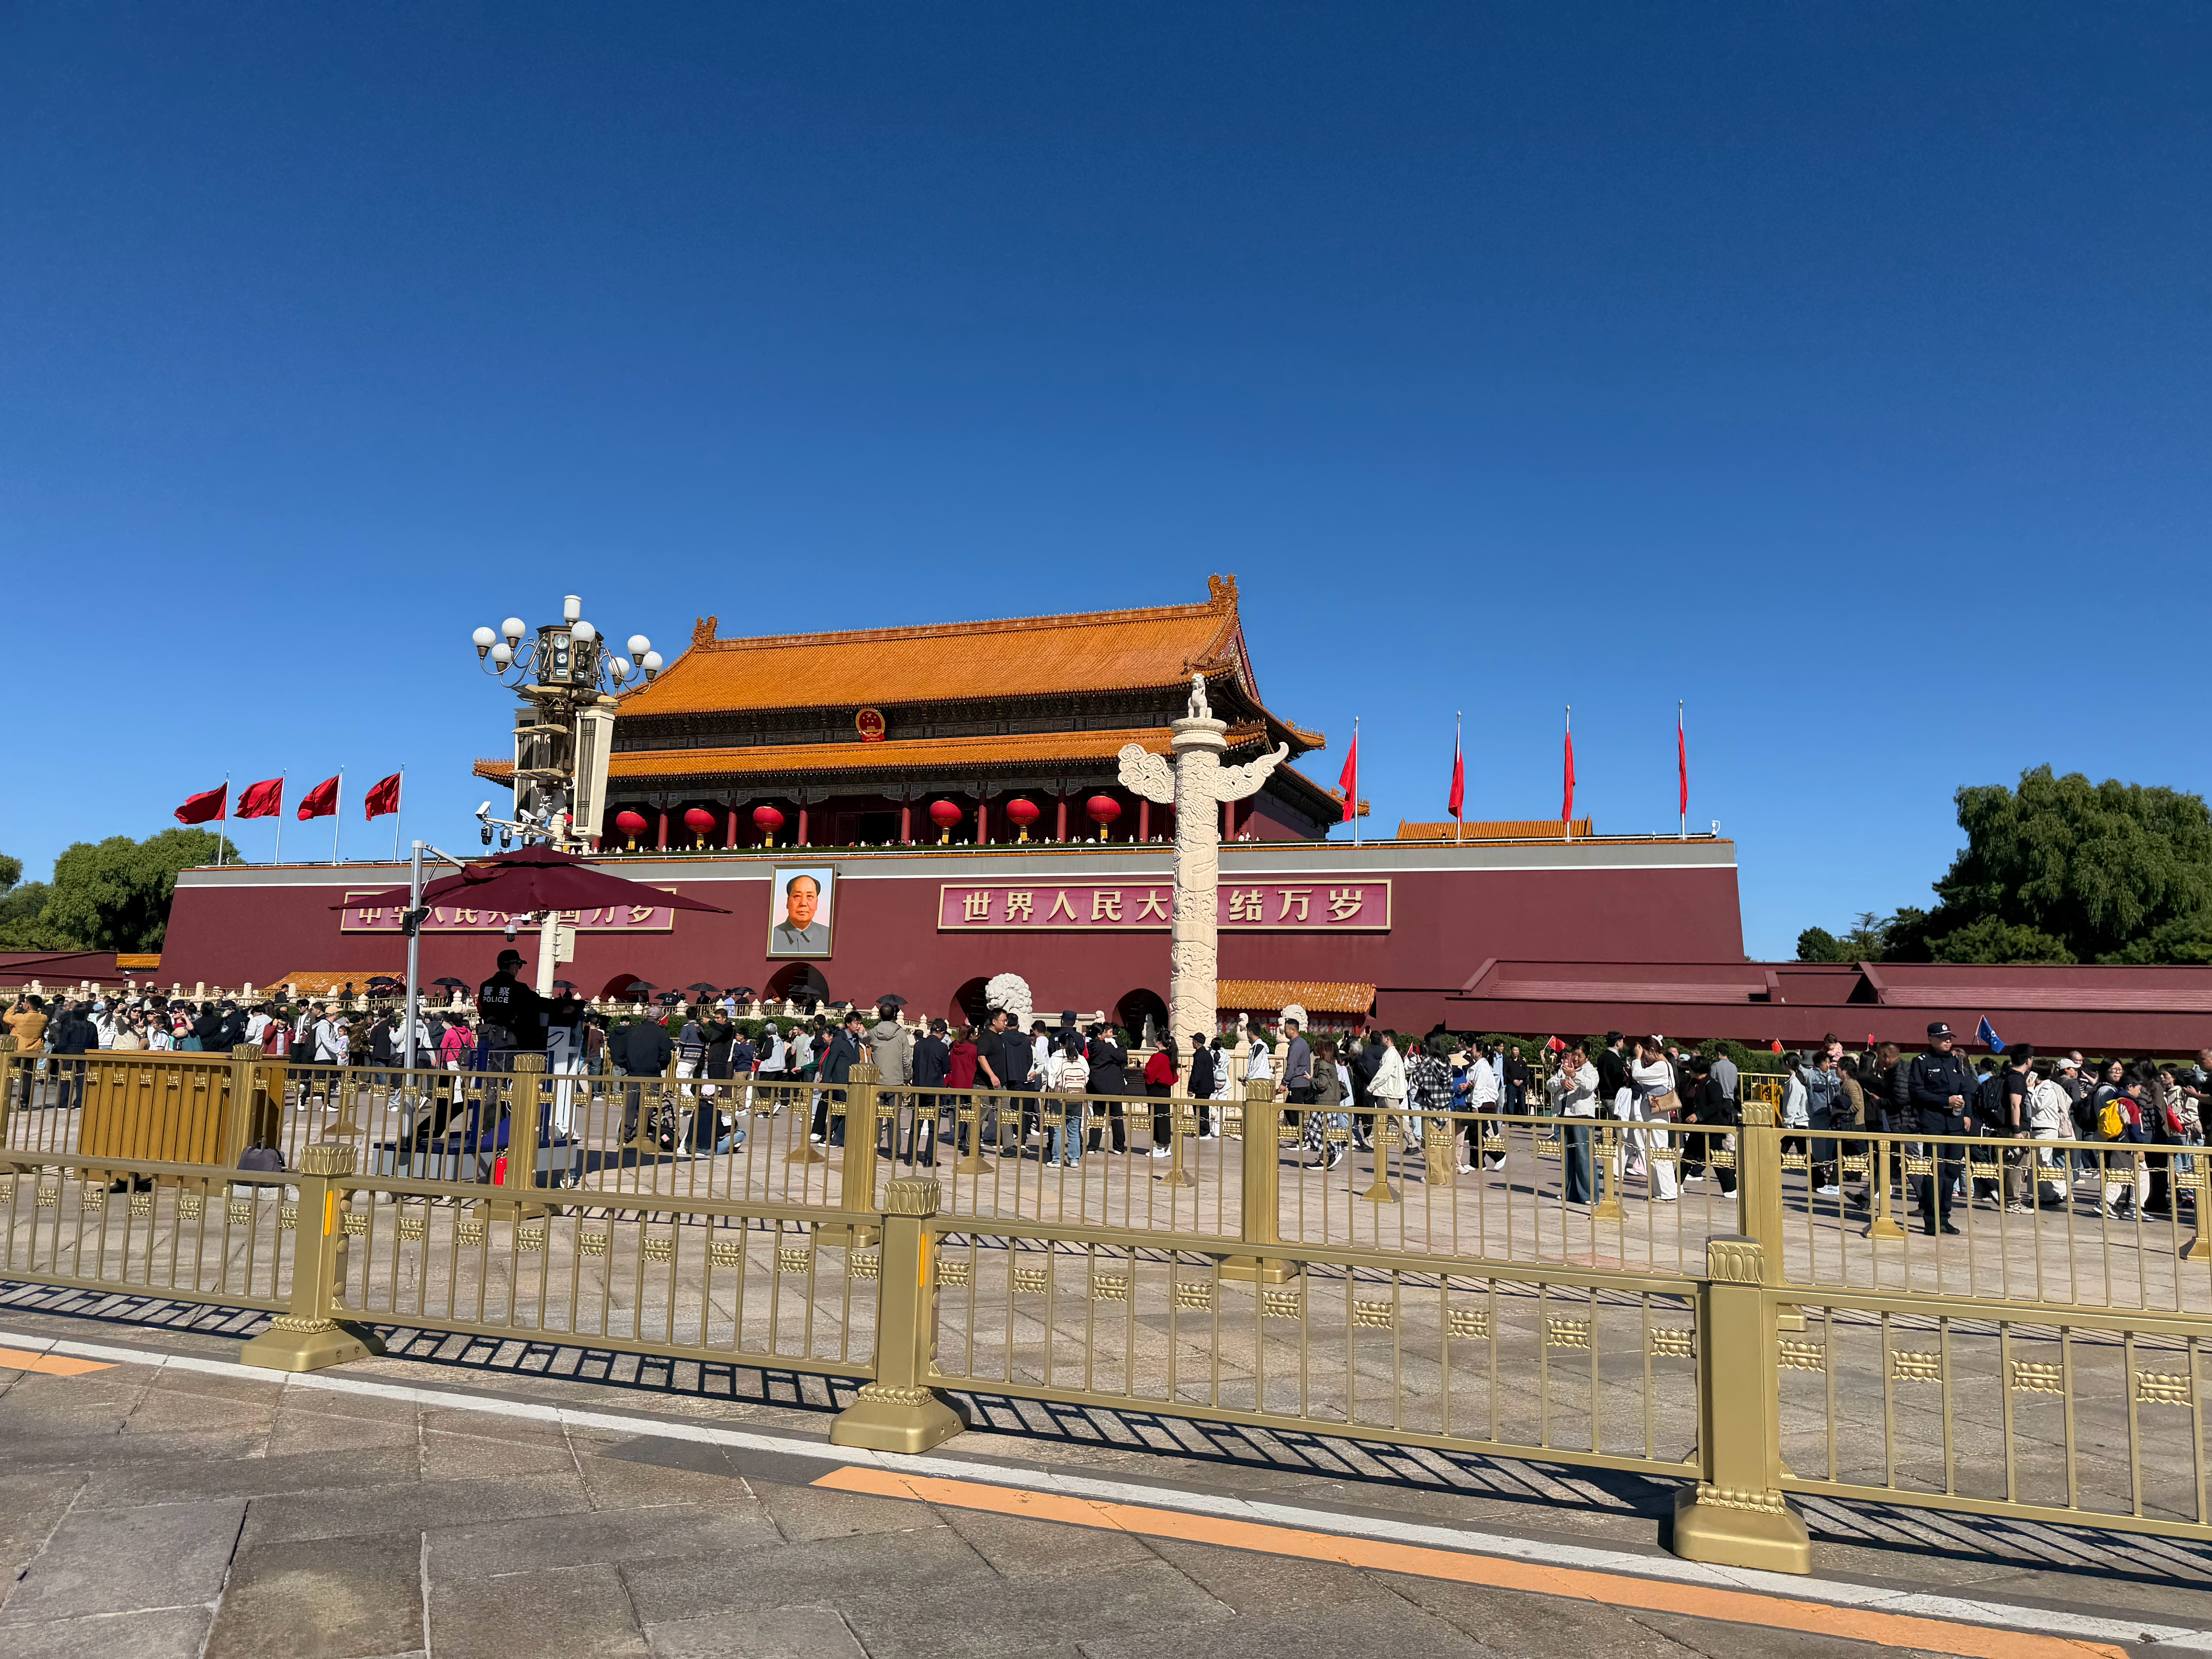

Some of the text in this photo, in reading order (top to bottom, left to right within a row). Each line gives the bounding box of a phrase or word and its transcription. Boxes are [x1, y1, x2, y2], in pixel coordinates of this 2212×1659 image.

[962, 889, 1363, 922] 世界人民大结万岁
[484, 986, 510, 996] 警察
